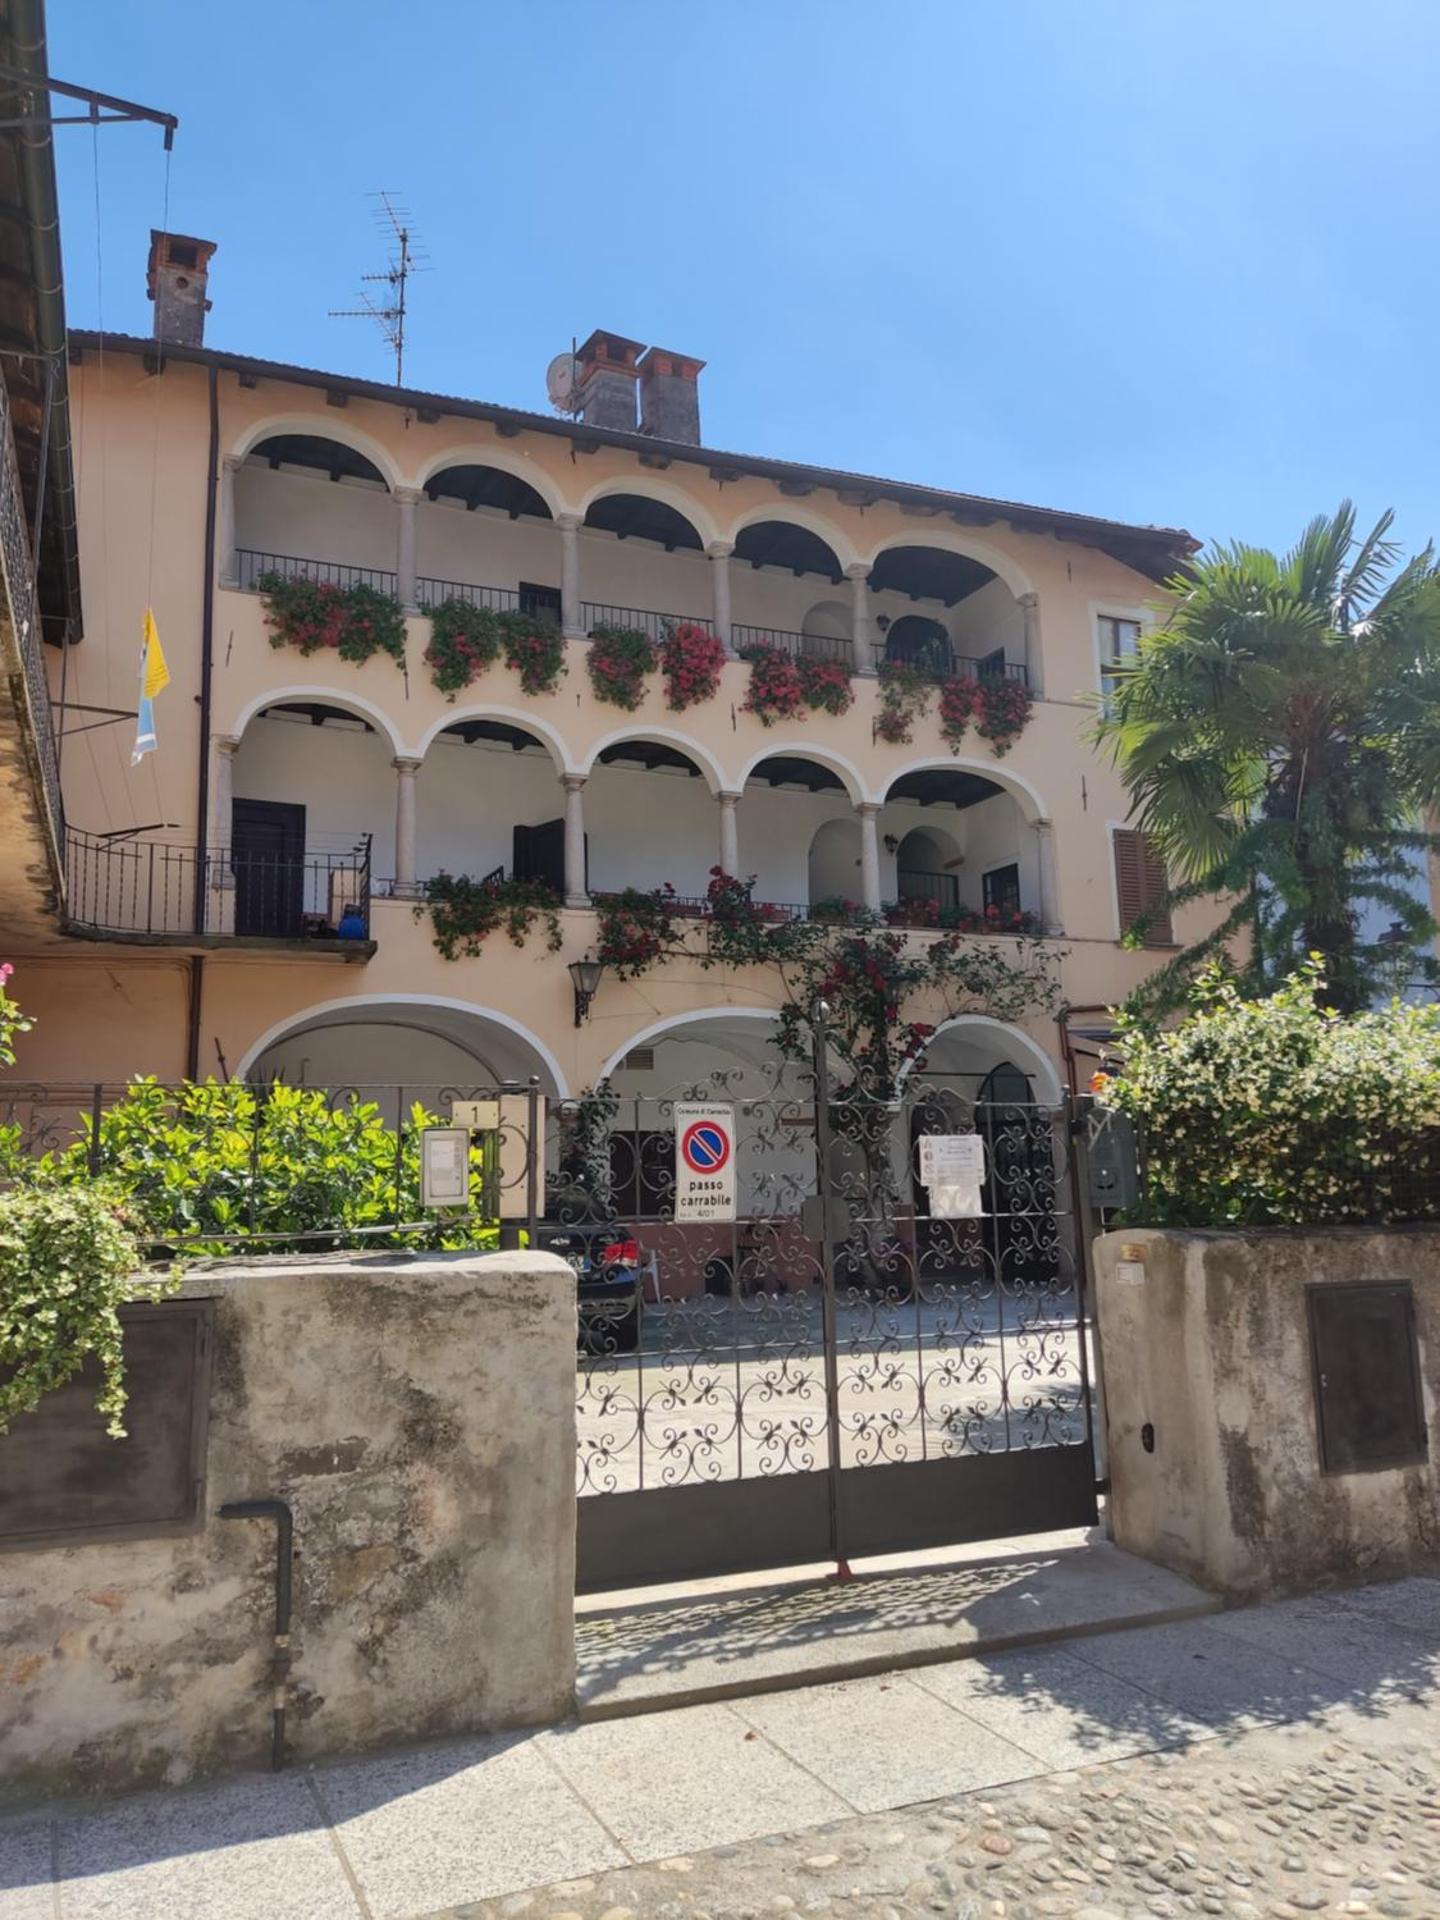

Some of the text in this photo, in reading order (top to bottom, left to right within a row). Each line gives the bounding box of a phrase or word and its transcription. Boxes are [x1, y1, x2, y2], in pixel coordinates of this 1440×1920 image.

[471, 1106, 478, 1123] 1
[689, 1181, 723, 1192] passo
[680, 1195, 731, 1206] carrabile
